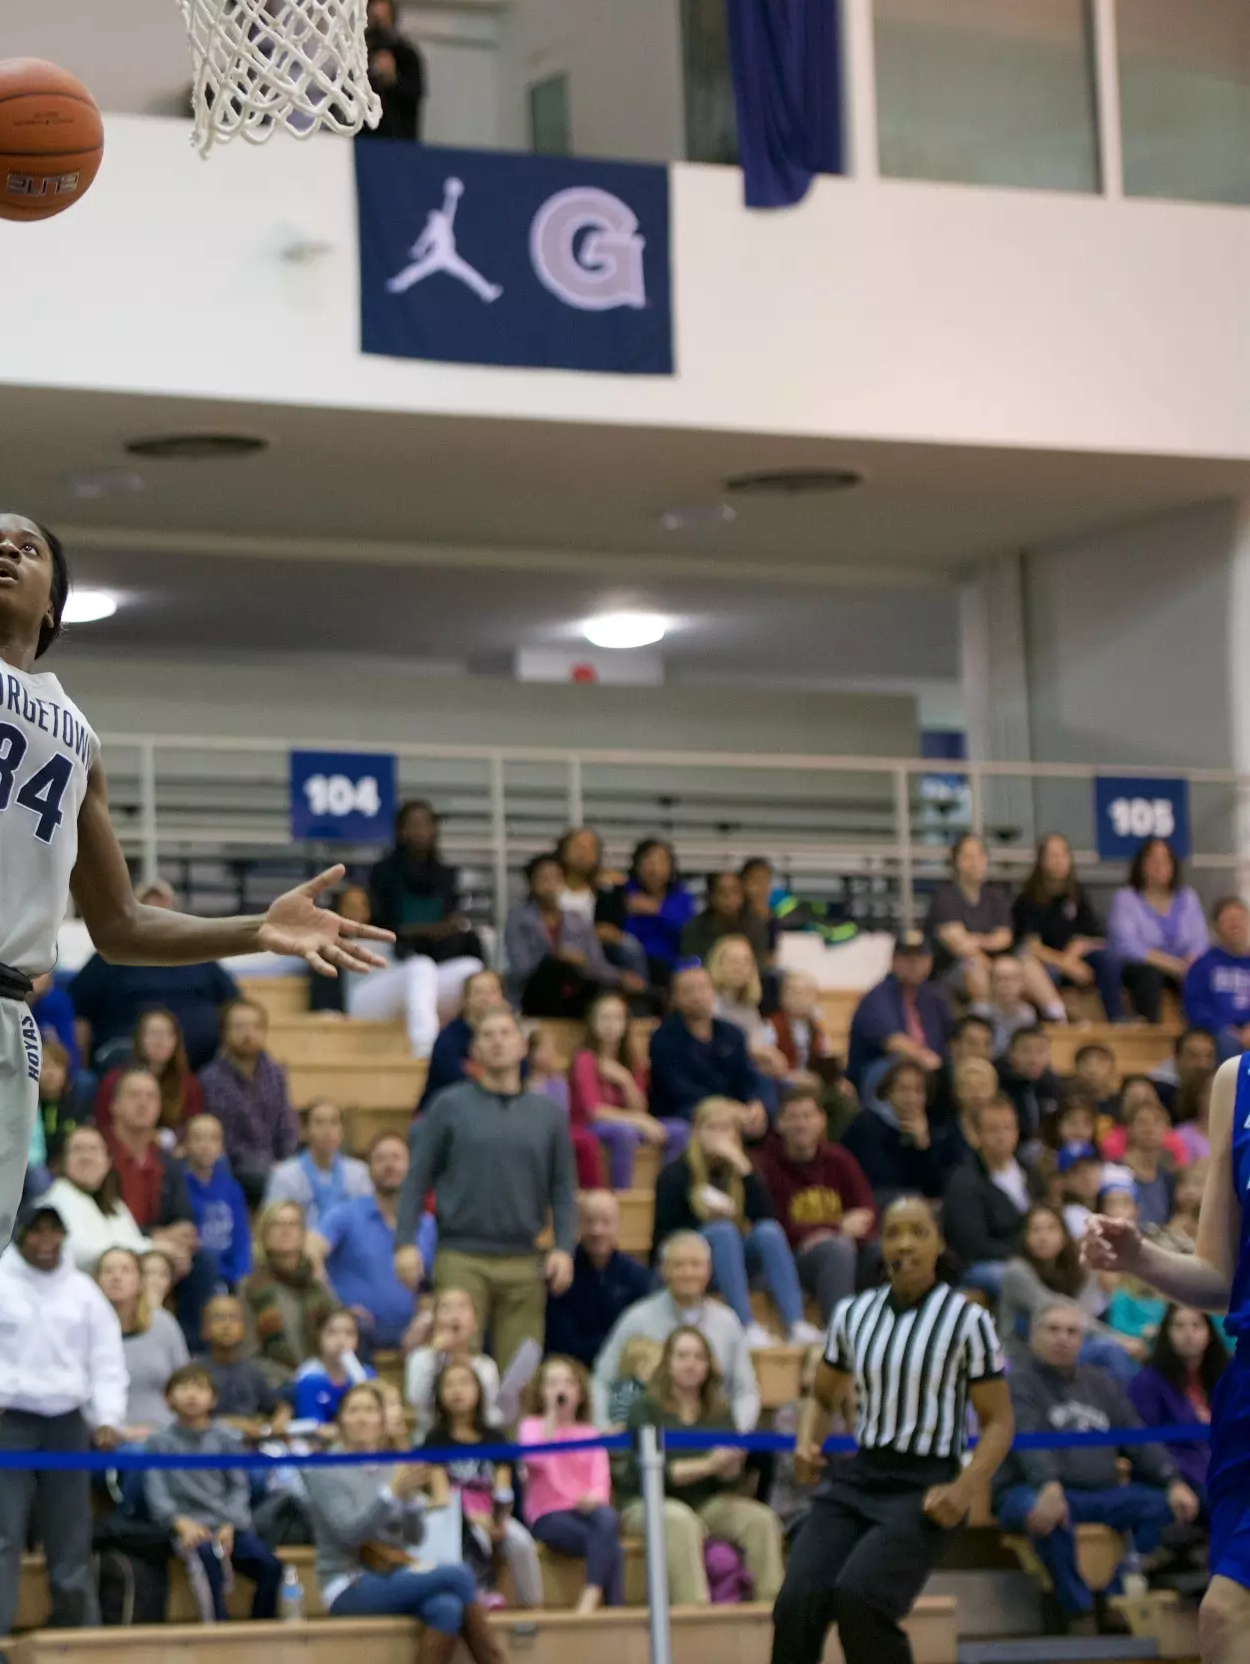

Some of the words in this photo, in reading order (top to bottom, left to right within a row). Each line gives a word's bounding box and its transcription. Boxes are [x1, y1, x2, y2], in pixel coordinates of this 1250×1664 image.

[530, 186, 646, 310] G
[303, 773, 381, 818] 104
[1106, 796, 1175, 838] 105
[21, 1015, 40, 1082] HOYAS
